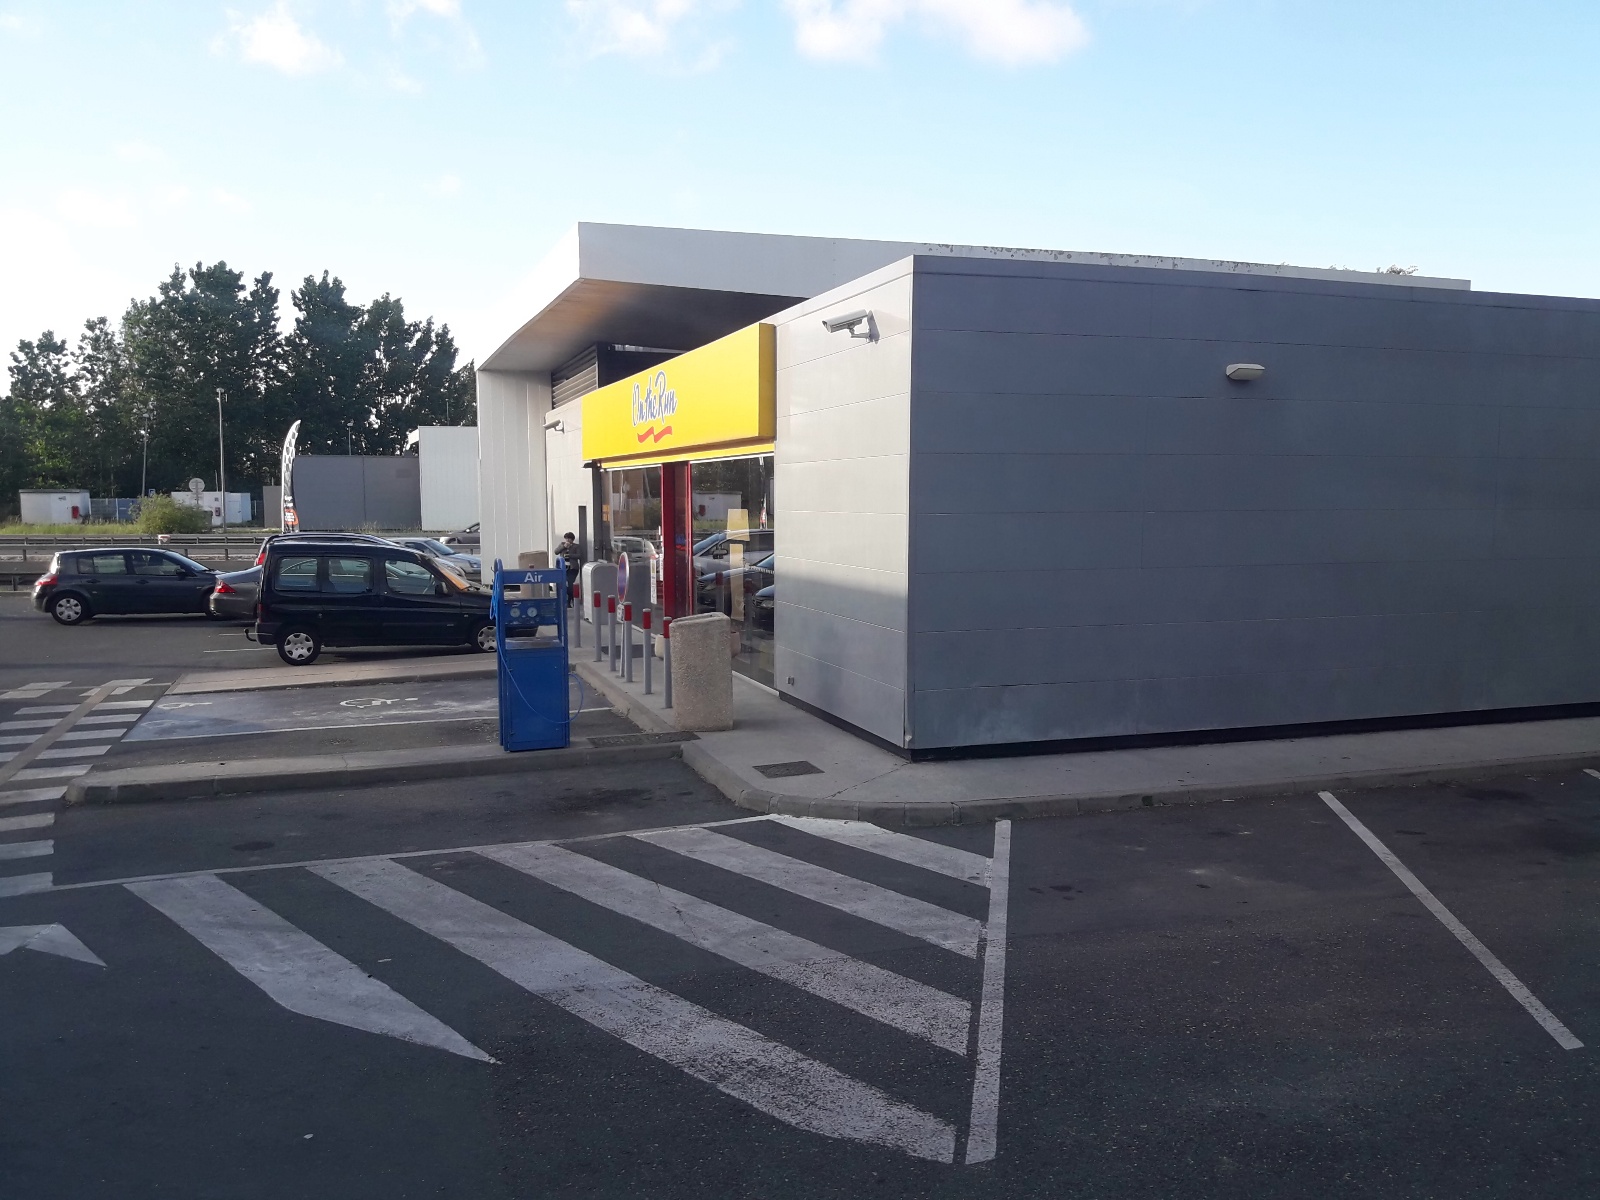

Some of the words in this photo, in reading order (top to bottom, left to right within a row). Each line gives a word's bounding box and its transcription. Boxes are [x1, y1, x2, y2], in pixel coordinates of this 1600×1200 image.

[632, 382, 646, 427] On
[645, 375, 658, 422] the
[654, 370, 678, 425] Run
[524, 571, 543, 583] Air
